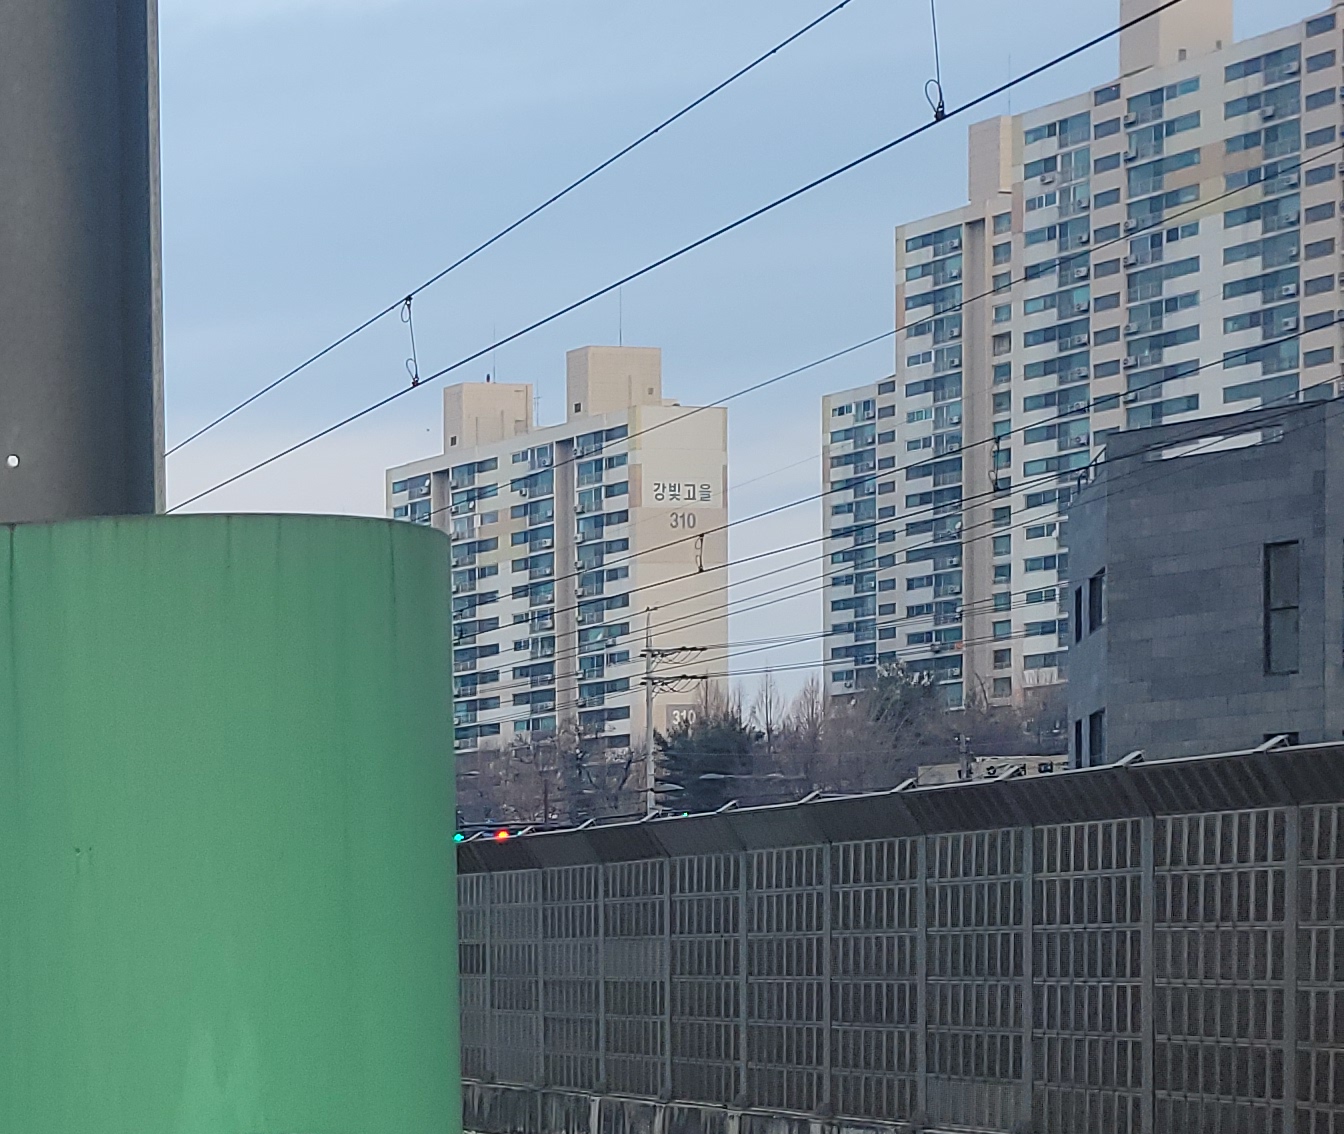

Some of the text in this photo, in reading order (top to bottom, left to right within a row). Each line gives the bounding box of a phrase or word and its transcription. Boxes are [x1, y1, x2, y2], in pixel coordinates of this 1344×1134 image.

[653, 482, 712, 502] 강빛고을
[669, 511, 696, 529] 310
[672, 709, 697, 725] 310
